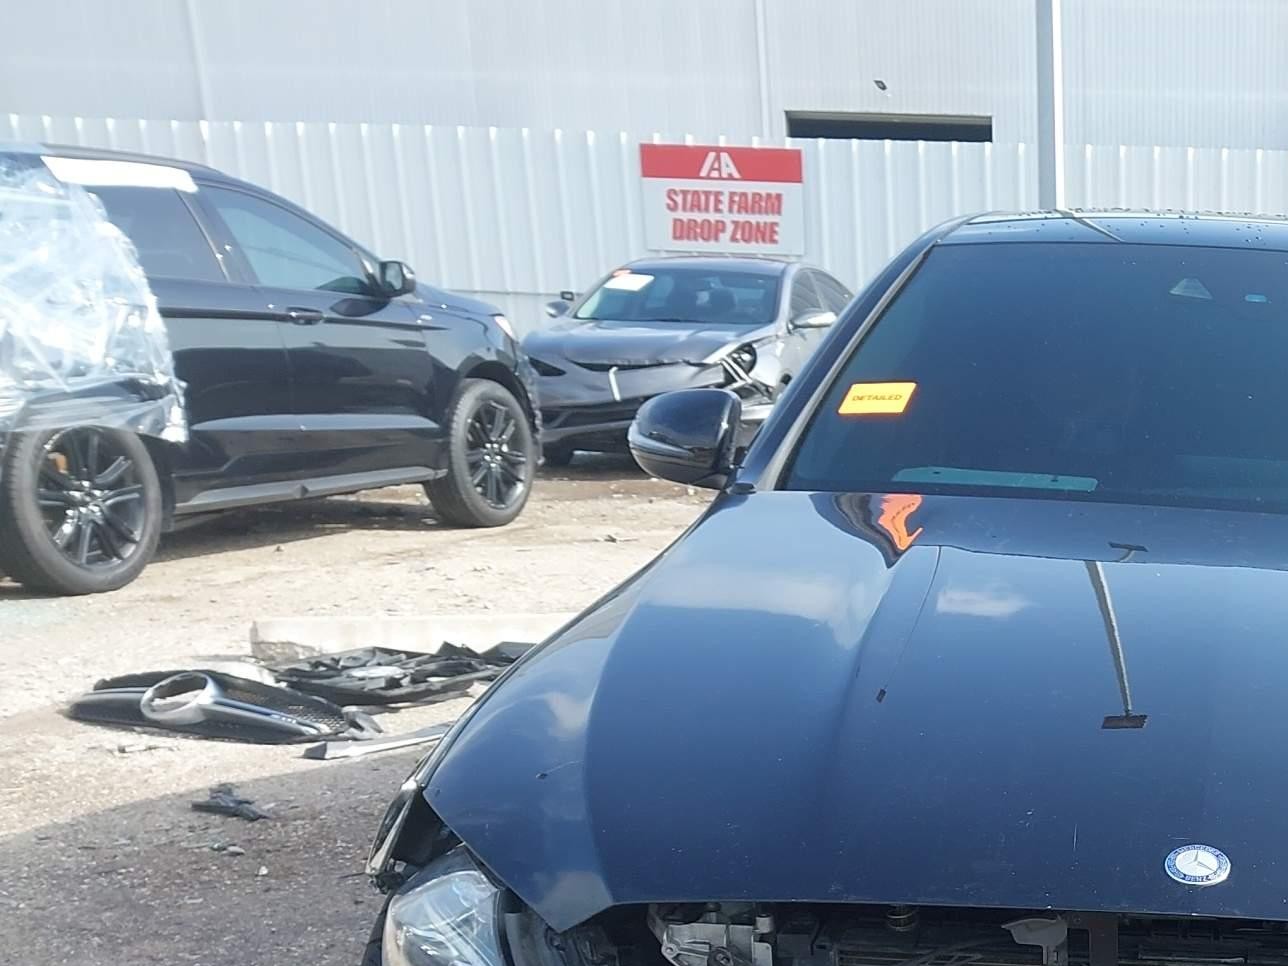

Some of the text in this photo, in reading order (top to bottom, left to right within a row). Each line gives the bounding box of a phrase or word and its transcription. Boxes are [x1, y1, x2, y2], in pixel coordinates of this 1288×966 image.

[666, 188, 783, 216] STATE FARM
[671, 218, 780, 244] DROP ZONE
